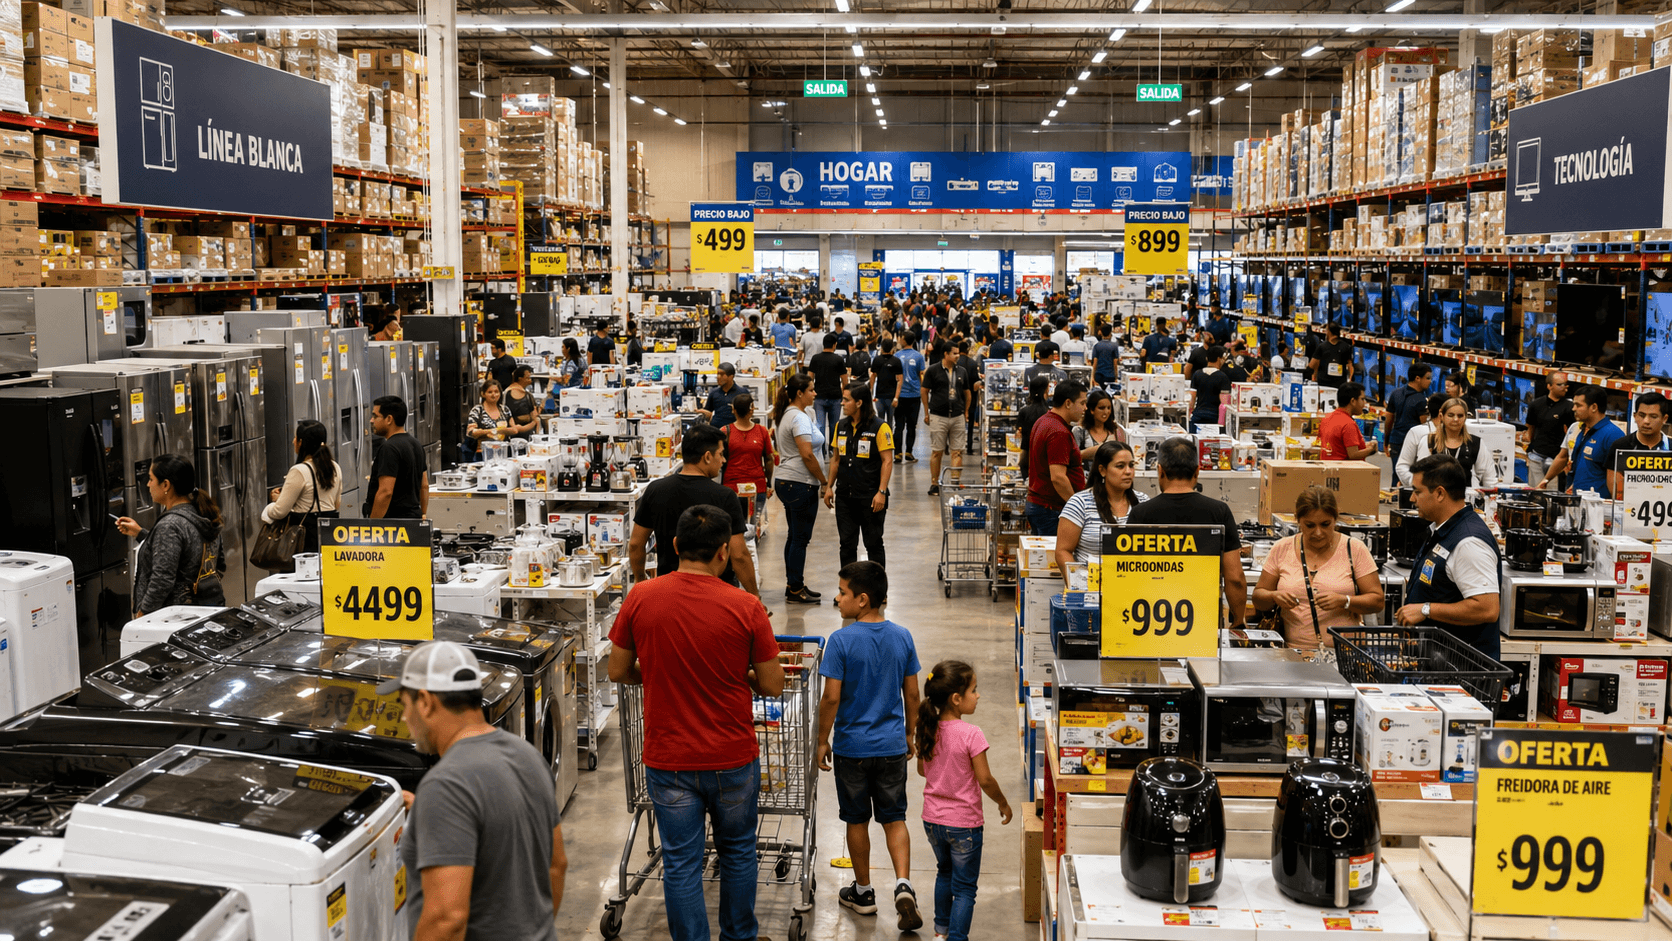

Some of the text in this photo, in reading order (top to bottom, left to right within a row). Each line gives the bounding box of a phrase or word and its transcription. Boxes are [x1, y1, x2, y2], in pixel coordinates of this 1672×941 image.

[806, 83, 845, 95] SALIDA
[1140, 87, 1180, 99] SALIDA
[197, 118, 304, 174] LÍNEA BLANCA
[1553, 135, 1633, 185] TECNOLOGÍA
[819, 161, 893, 182] HOGAR
[694, 210, 750, 219] PRECIO BAJO
[1128, 211, 1186, 220] PRECIO BAJO
[696, 228, 746, 251] $499
[1130, 229, 1180, 253] $899
[1626, 456, 1672, 470] OFERT
[333, 525, 411, 544] OFERTA
[1115, 533, 1198, 553] OFERTA
[334, 551, 385, 562] LAVADORA
[1116, 561, 1184, 573] MICROONDAS
[334, 585, 423, 622] $4499
[1122, 598, 1195, 637] $999
[1497, 739, 1609, 767] OFERTA
[1496, 778, 1612, 795] FREIDORA DE AIRE
[1496, 834, 1605, 893] $999
